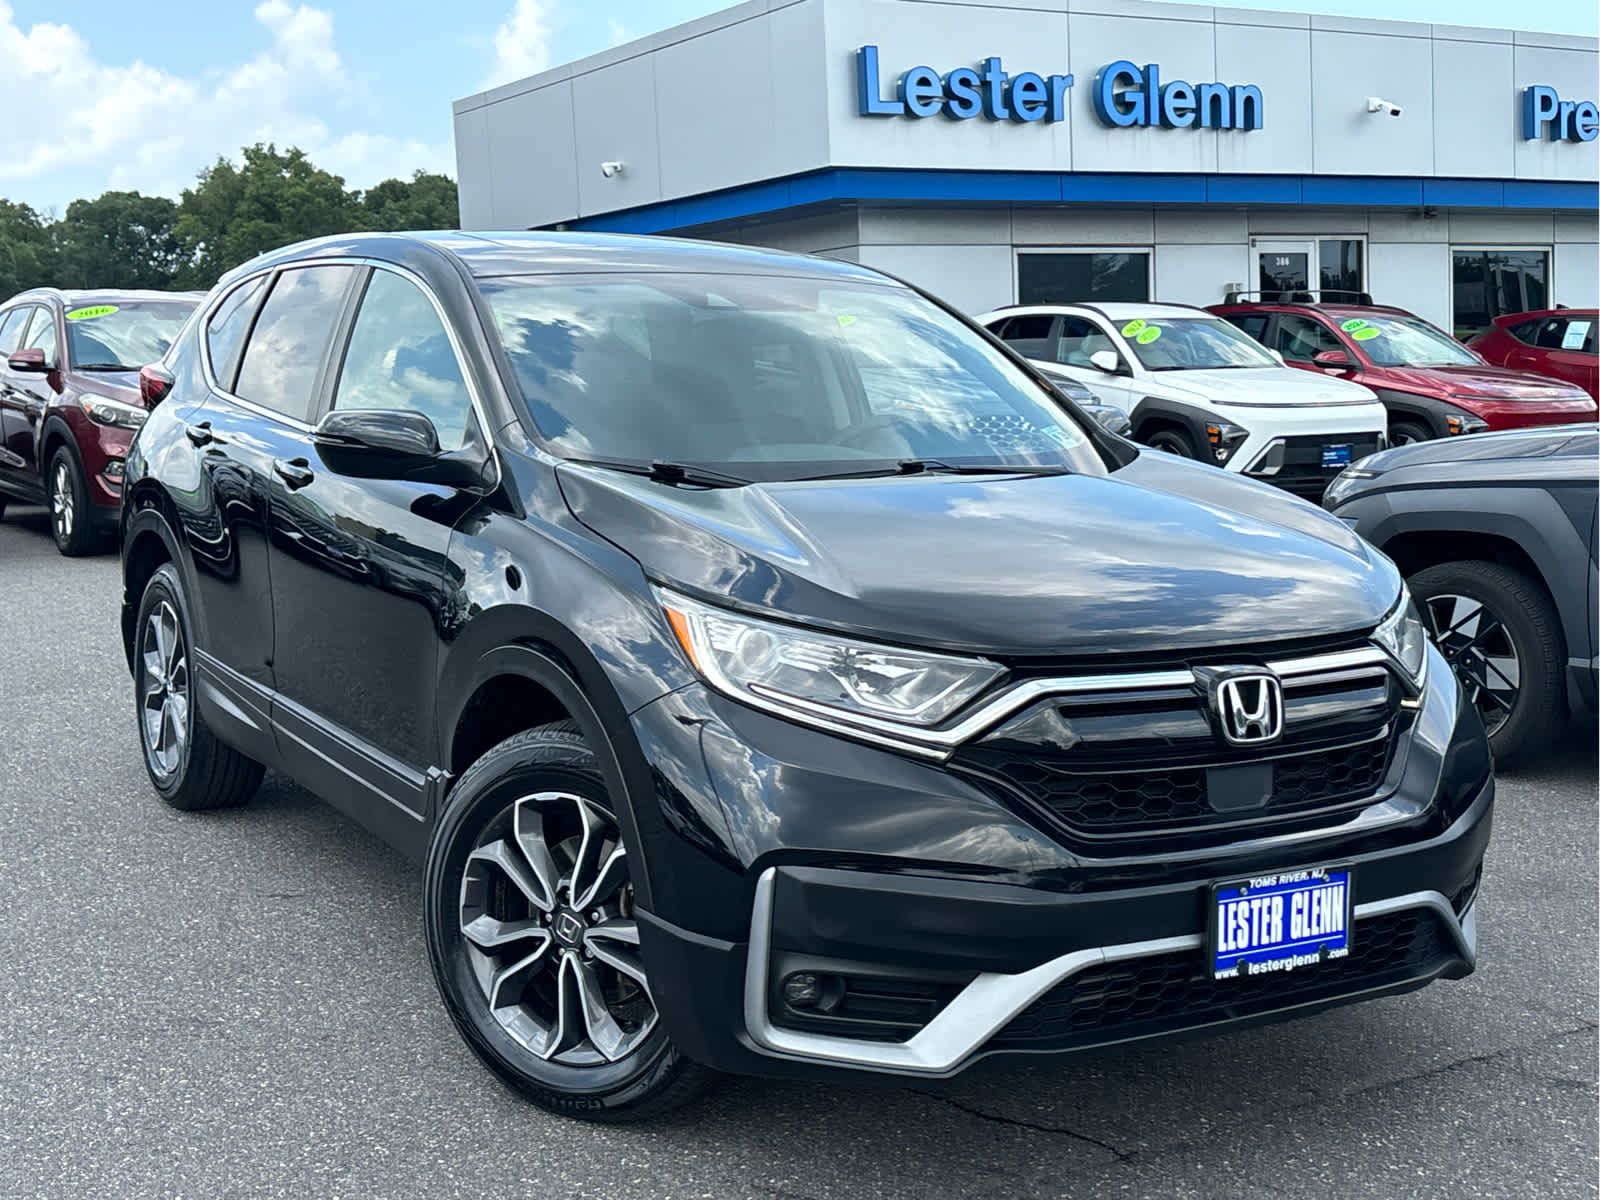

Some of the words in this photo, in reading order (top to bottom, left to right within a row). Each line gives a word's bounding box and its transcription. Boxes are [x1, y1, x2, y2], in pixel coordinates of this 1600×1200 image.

[857, 45, 1073, 122] Lester
[1094, 60, 1263, 130] Glenn
[1249, 876, 1277, 889] TOMS
[1217, 895, 1284, 953] LESTER
[1290, 885, 1345, 940] GLENN
[1247, 952, 1320, 975] lesterglenn
